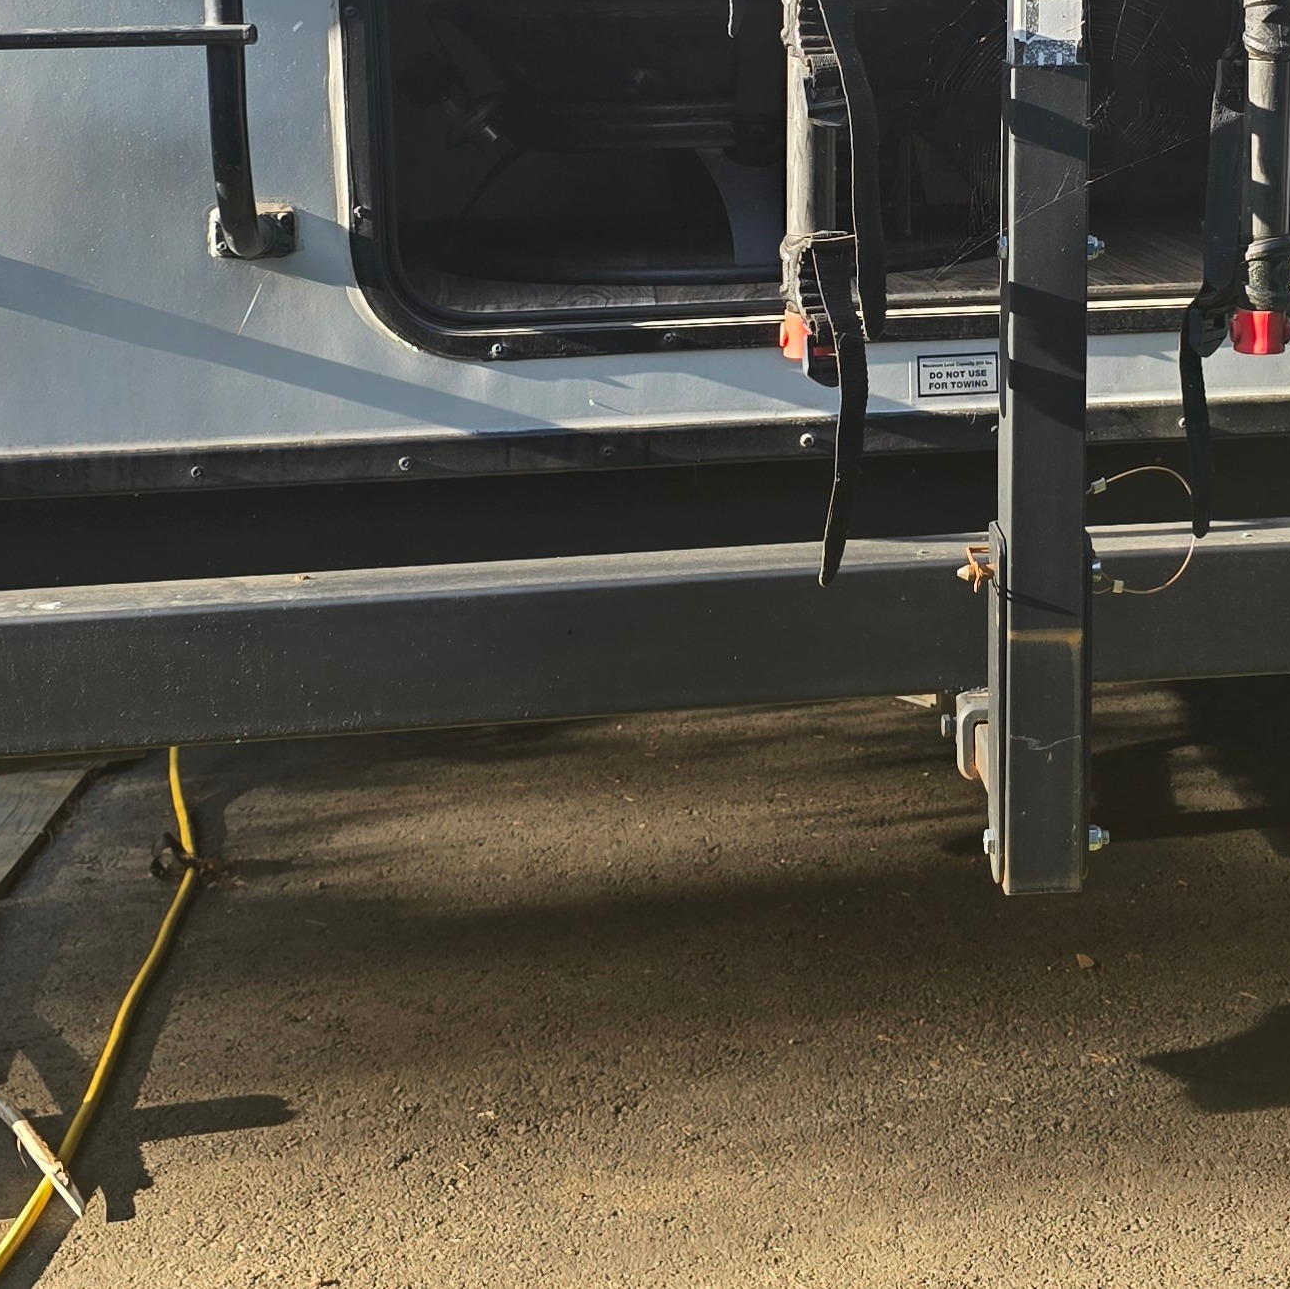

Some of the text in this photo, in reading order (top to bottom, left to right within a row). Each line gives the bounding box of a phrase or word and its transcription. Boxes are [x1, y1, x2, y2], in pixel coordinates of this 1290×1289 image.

[929, 369, 987, 379] DO NOT USE
[929, 380, 988, 390] FOR TOWING
